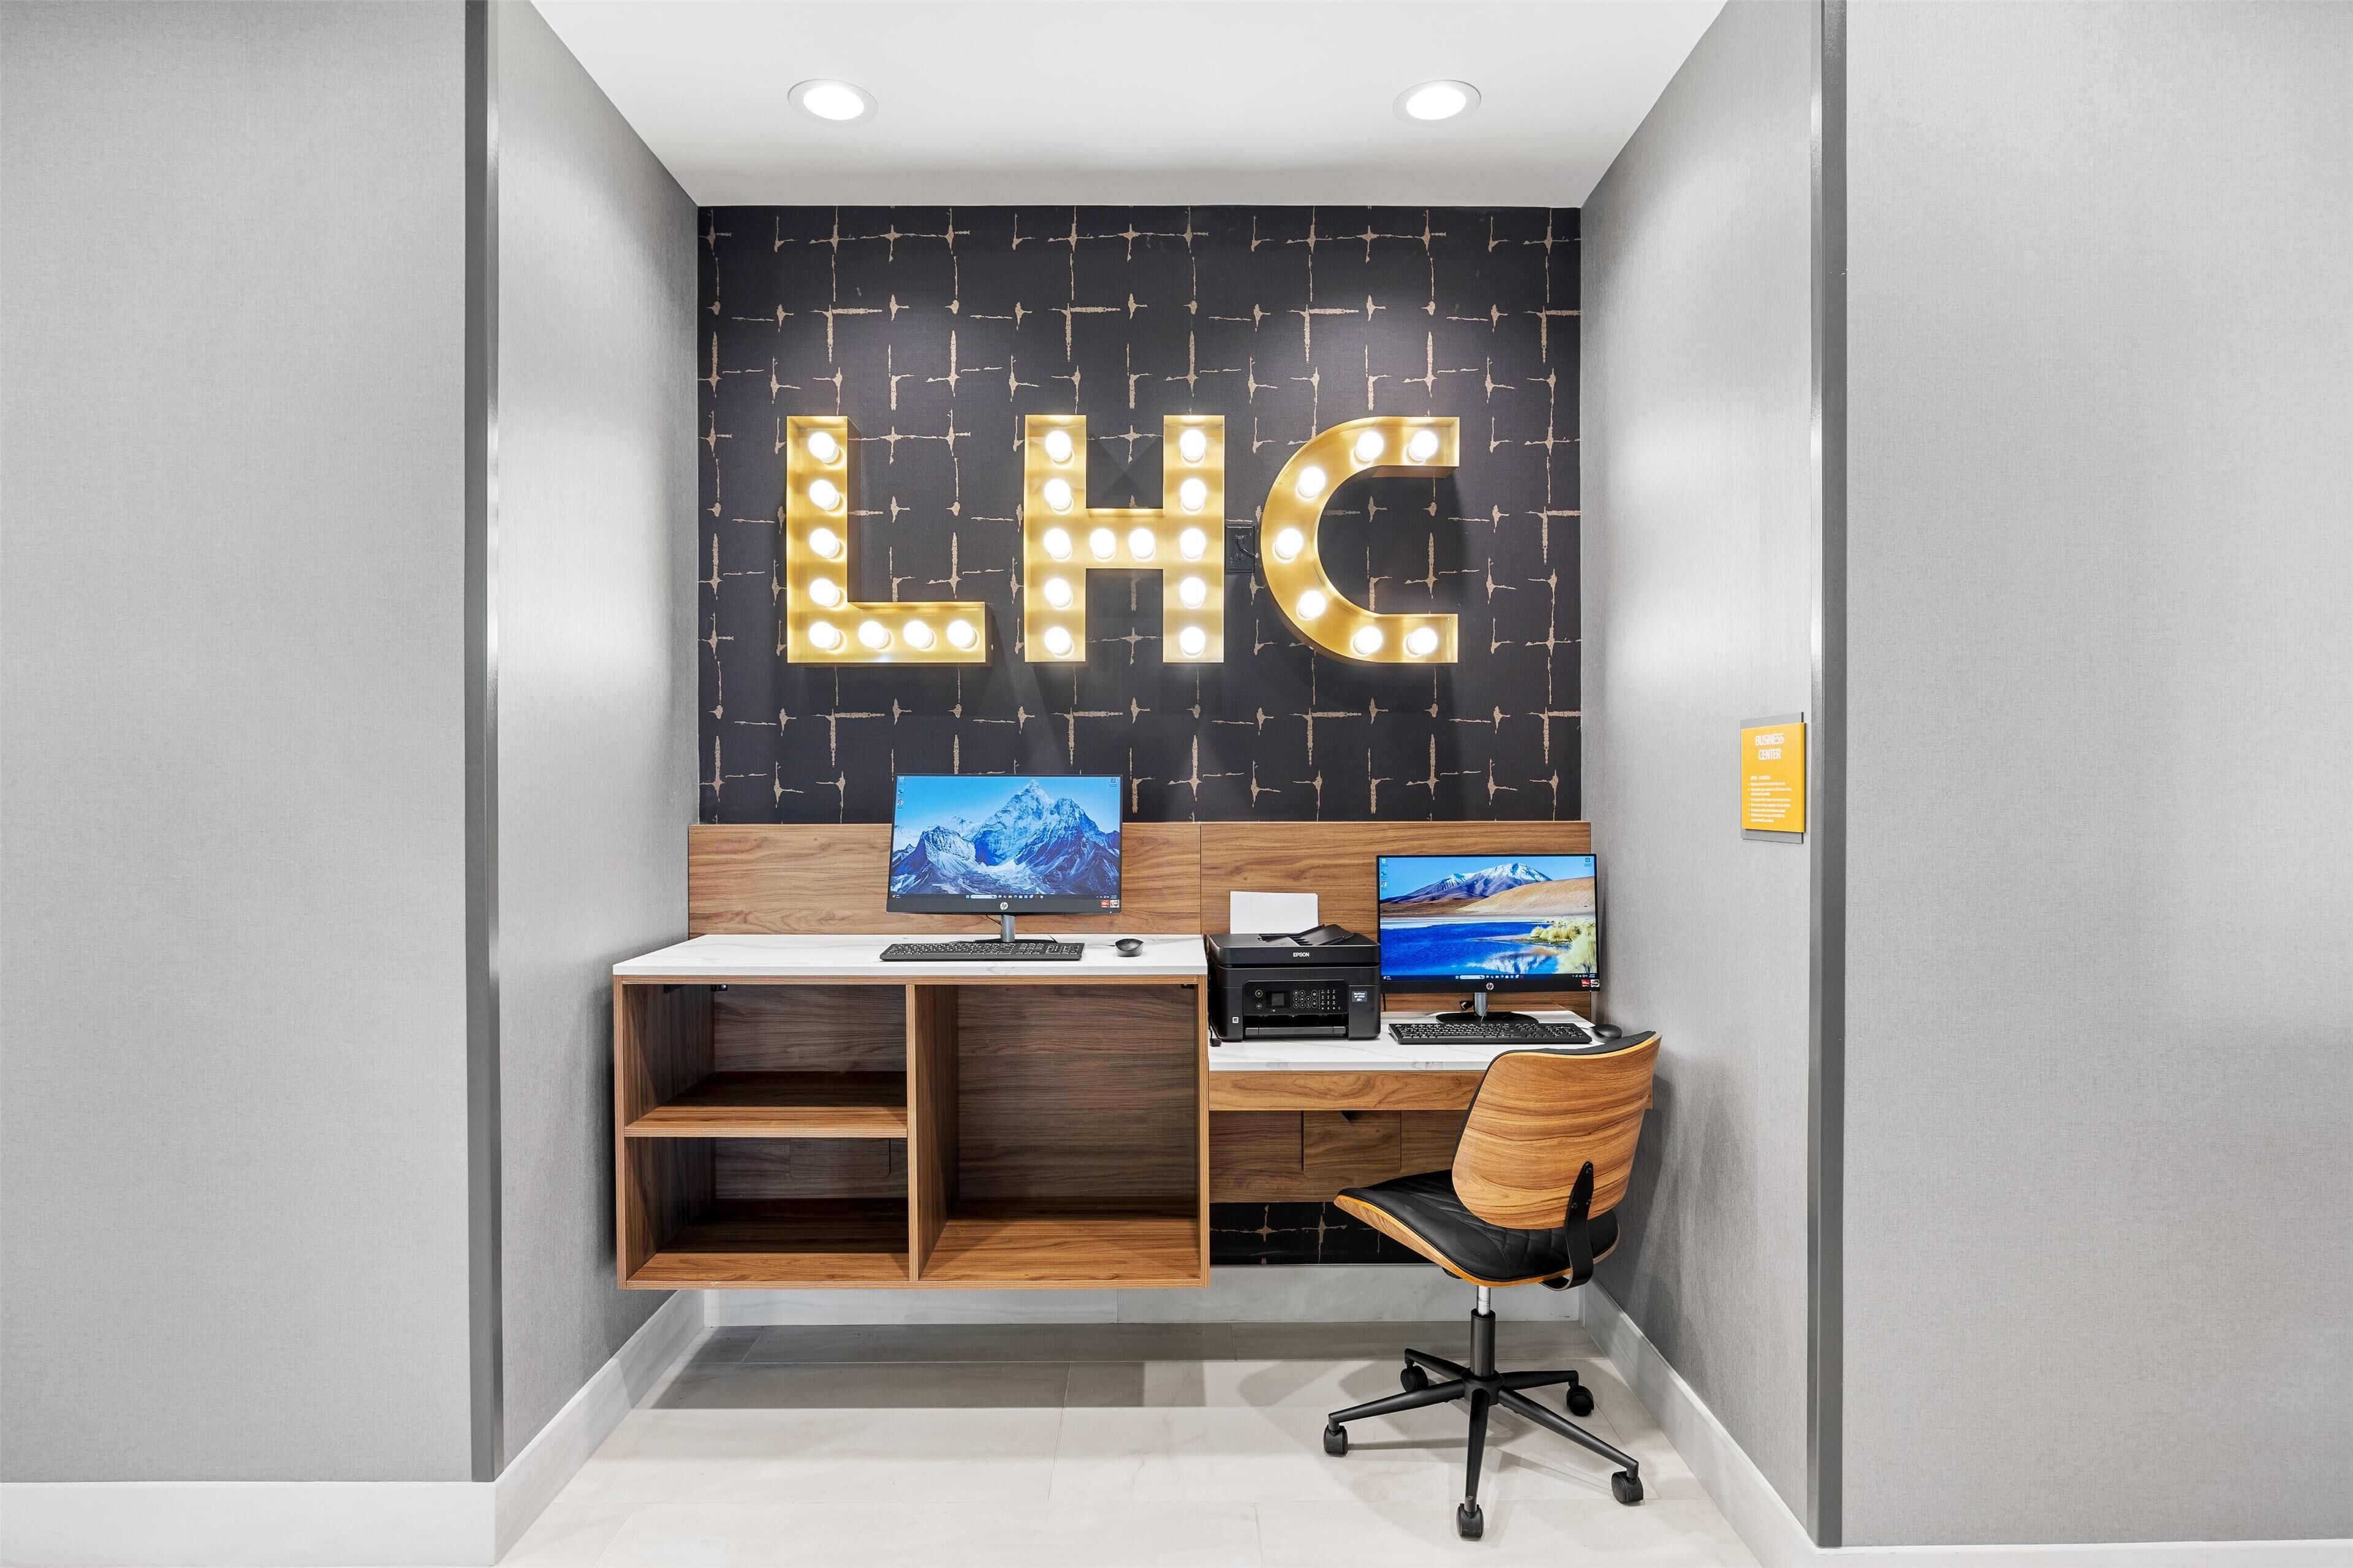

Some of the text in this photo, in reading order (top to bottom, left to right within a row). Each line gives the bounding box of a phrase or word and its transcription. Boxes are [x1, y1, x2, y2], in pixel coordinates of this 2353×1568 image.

[786, 414, 1460, 665] LHC
[1755, 733, 1784, 746] BUSINESS
[1758, 748, 1782, 760] CENTER
